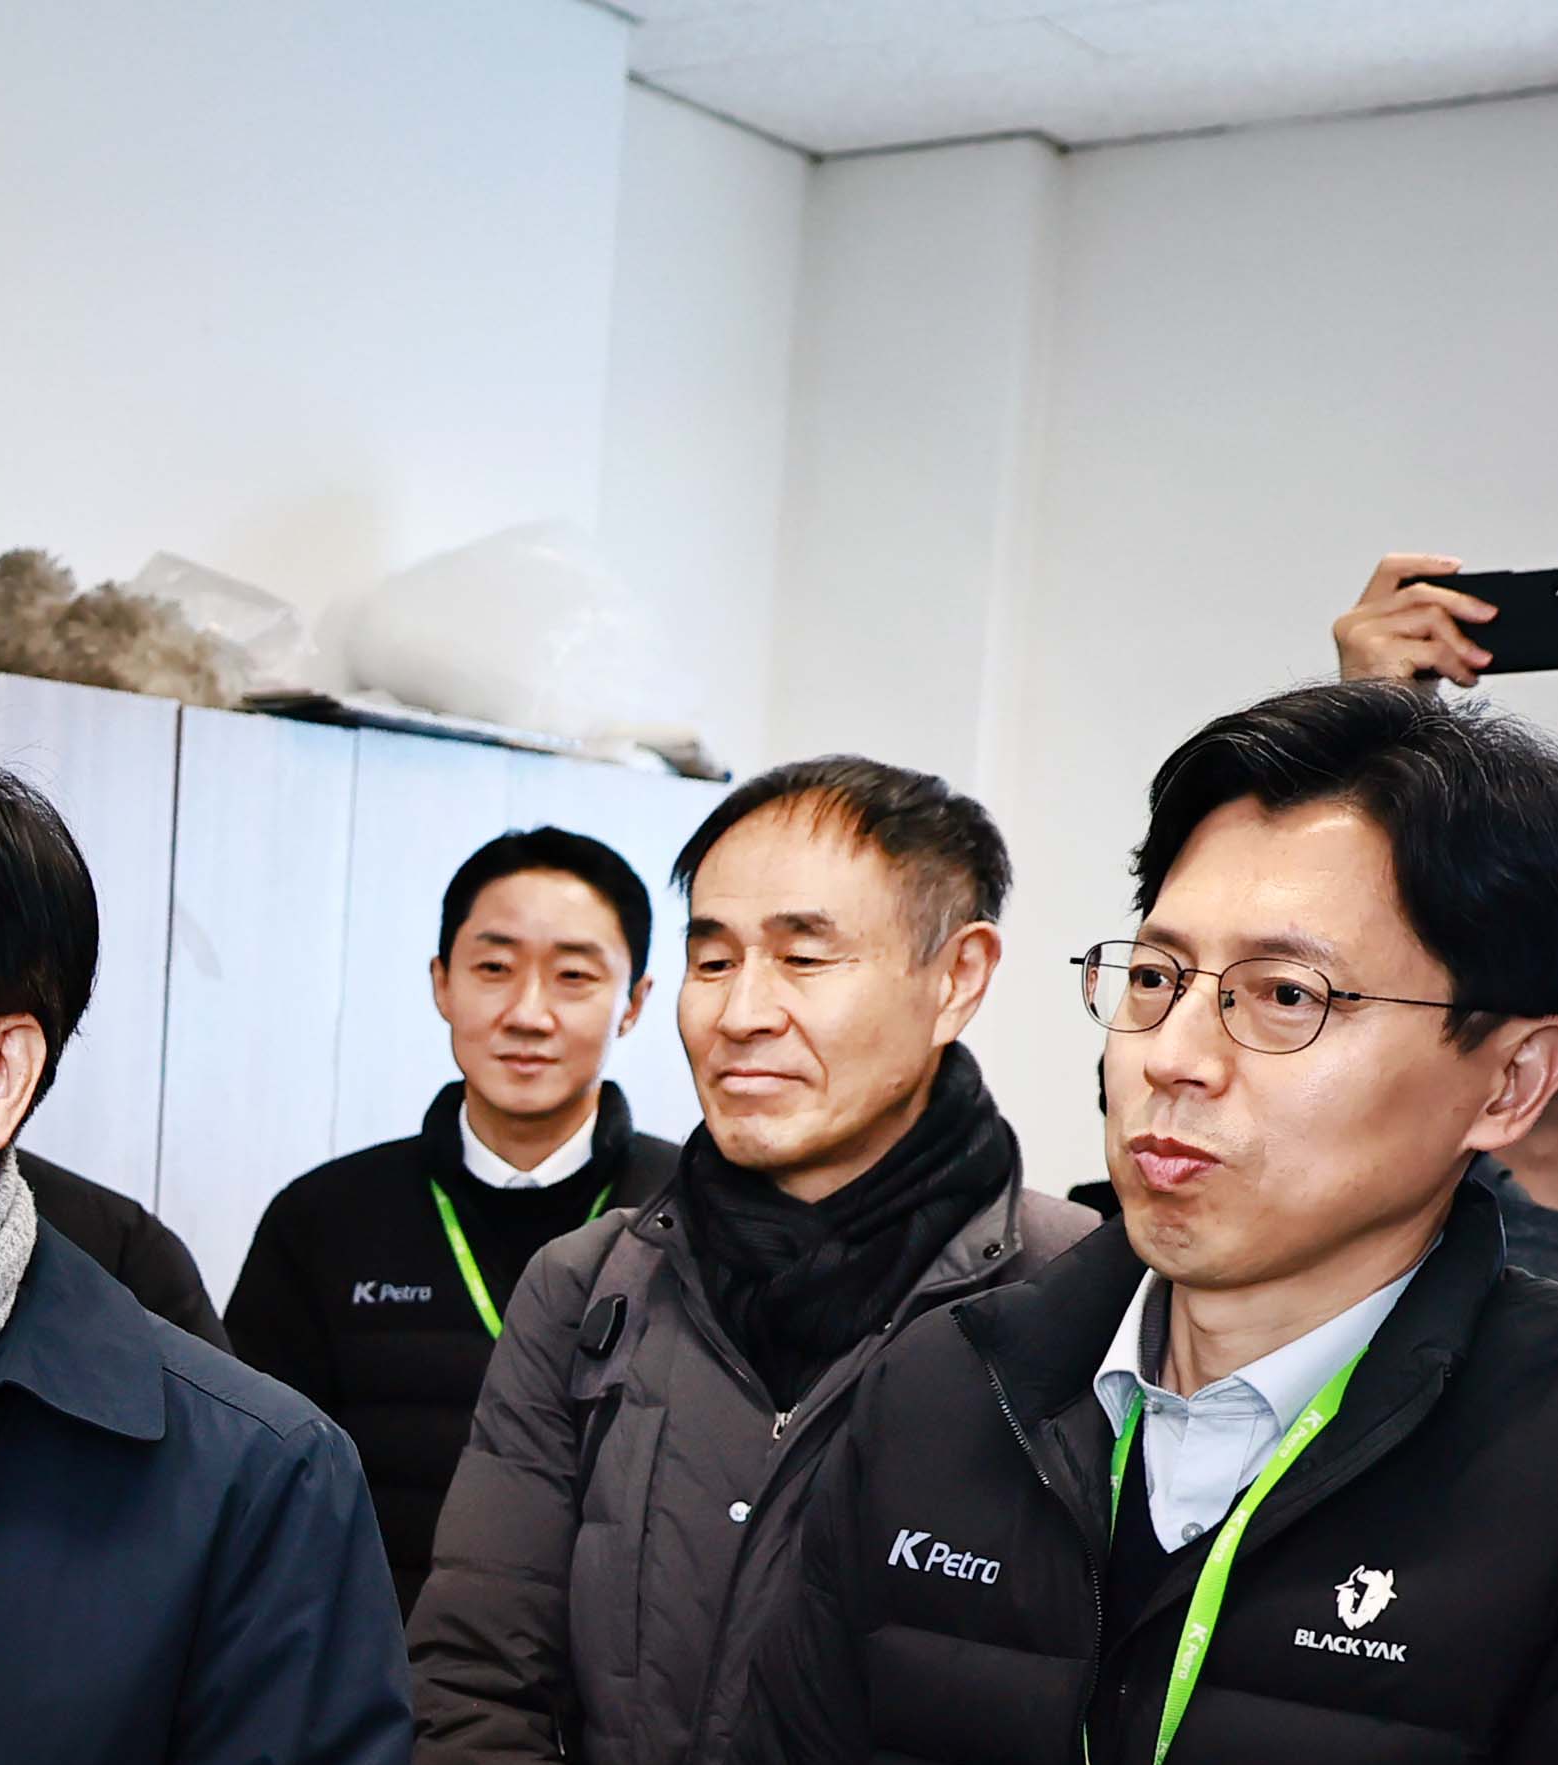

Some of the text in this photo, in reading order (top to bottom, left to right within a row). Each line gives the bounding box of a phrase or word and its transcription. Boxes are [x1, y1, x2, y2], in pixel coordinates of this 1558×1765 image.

[887, 1529, 1001, 1584] K Petro
[1294, 1628, 1407, 1662] BLACK YAK
